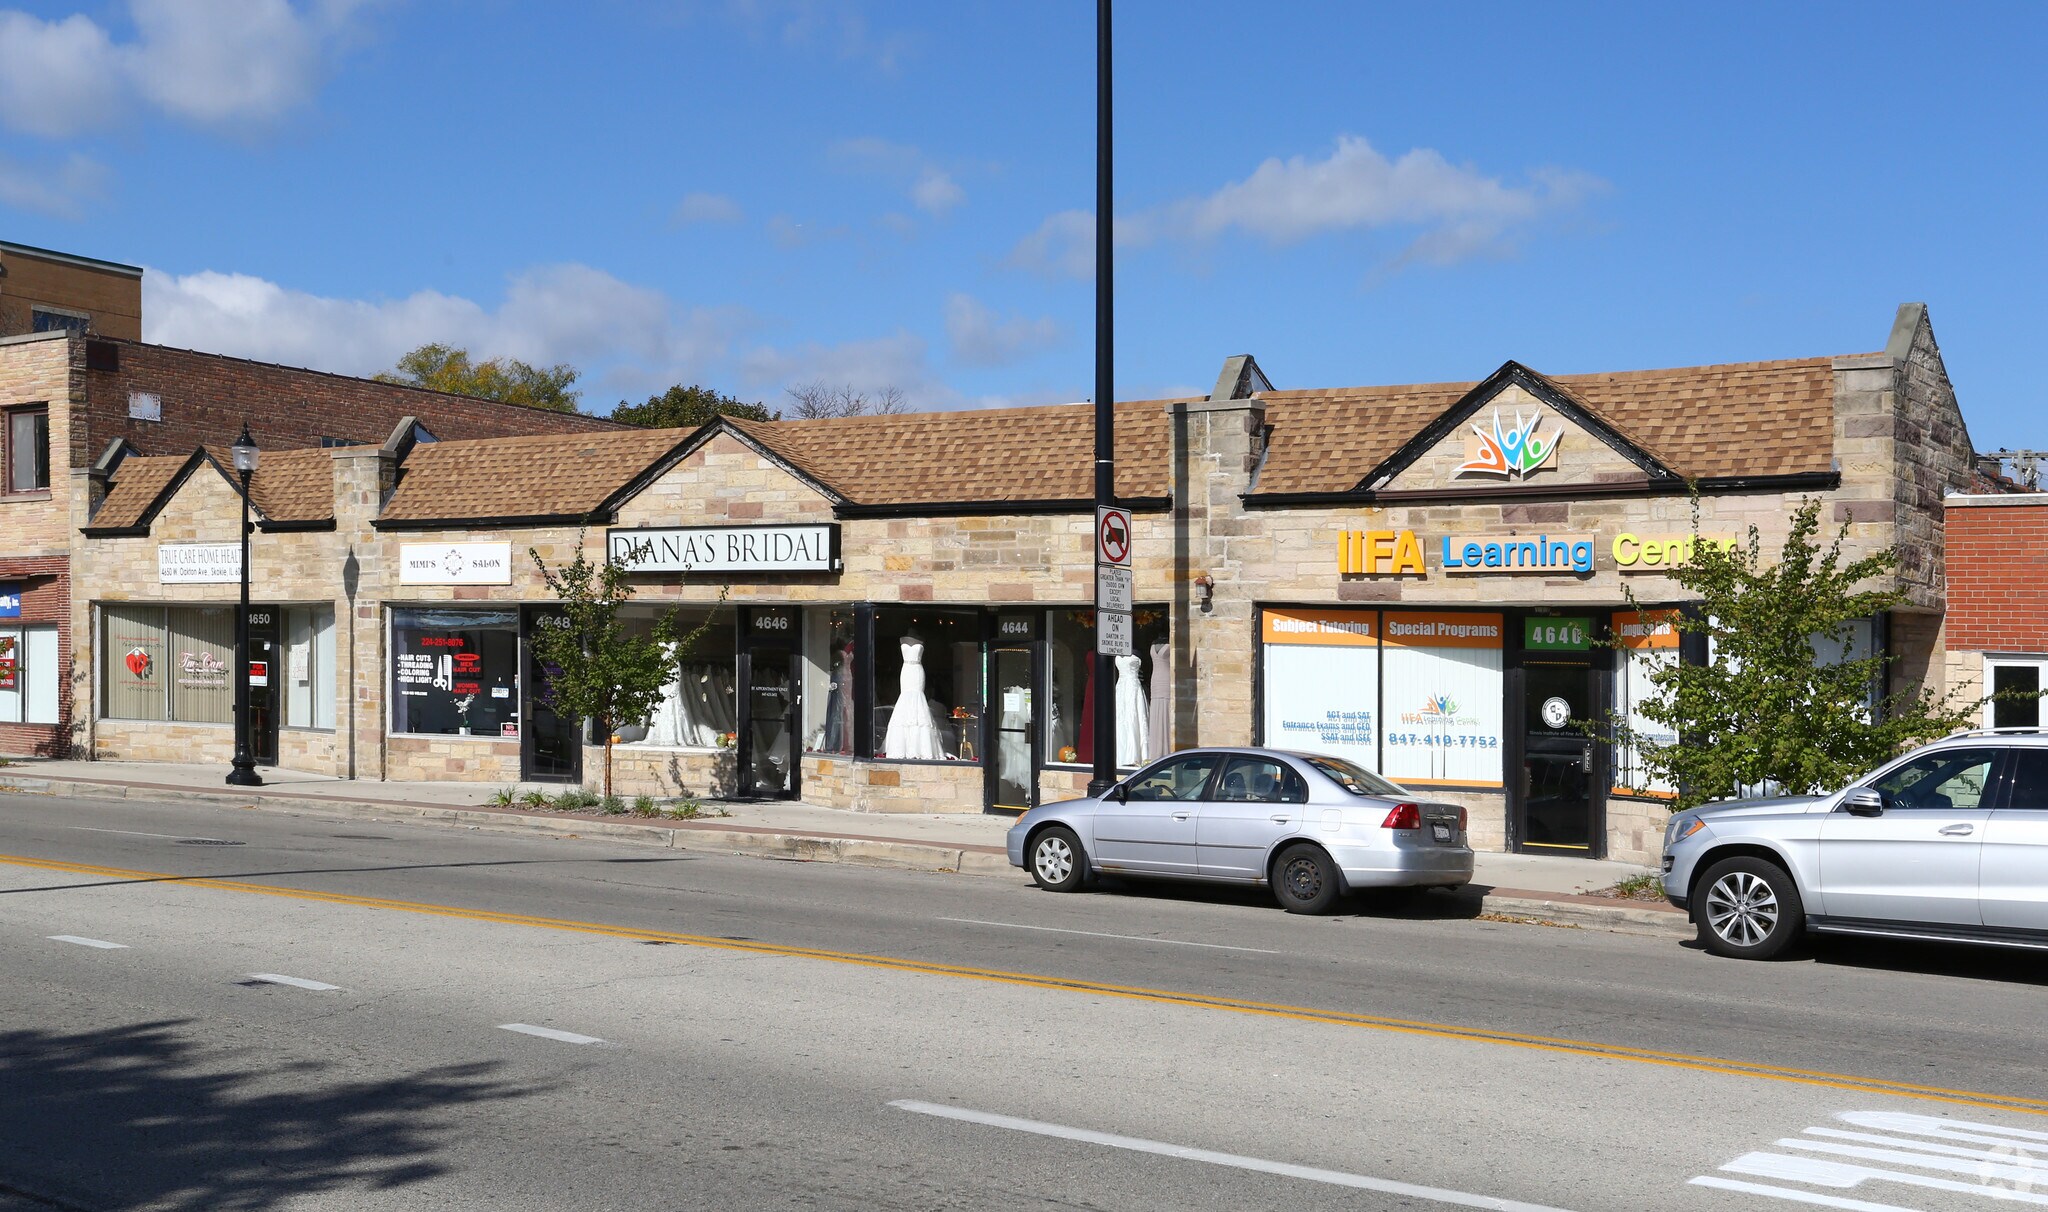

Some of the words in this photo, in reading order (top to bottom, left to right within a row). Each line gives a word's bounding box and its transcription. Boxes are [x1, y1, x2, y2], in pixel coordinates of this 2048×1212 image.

[613, 534, 715, 563] DIANA'S
[727, 532, 828, 562] BRIDAL
[1338, 529, 1426, 574] IIFA
[1441, 534, 1593, 573] Learning
[160, 549, 178, 564] TRUE
[179, 548, 196, 564] CARE
[198, 548, 219, 564] HOME
[221, 548, 243, 564] HEALT
[409, 560, 437, 569] MIMI'S
[472, 559, 500, 568] SALON
[161, 567, 172, 576] 4650
[180, 567, 197, 576] Oakton
[249, 613, 270, 624] 4650
[755, 616, 788, 630] 4646
[1108, 615, 1123, 623] AHEAD
[1001, 621, 1028, 633] 4644
[1112, 624, 1119, 632] ON
[1272, 618, 1318, 634] Subject
[1319, 619, 1369, 636] Tutoring
[1389, 621, 1435, 636] Special
[1438, 622, 1498, 637] Programs
[1532, 626, 1582, 644] 4640
[415, 654, 432, 662] CUTS
[400, 661, 434, 669] THREADING
[400, 668, 430, 676] COLORING
[415, 676, 433, 684] LIGHT
[1326, 710, 1340, 719] ACT
[1341, 711, 1356, 719] and
[1357, 711, 1370, 719] SAT
[1282, 720, 1315, 729] Entrance
[1316, 721, 1340, 730] Exams
[1341, 722, 1355, 730] and
[1356, 722, 1371, 731] GED
[1321, 732, 1339, 741] SSAT
[1340, 733, 1354, 741] and
[1356, 733, 1371, 742] ISEE
